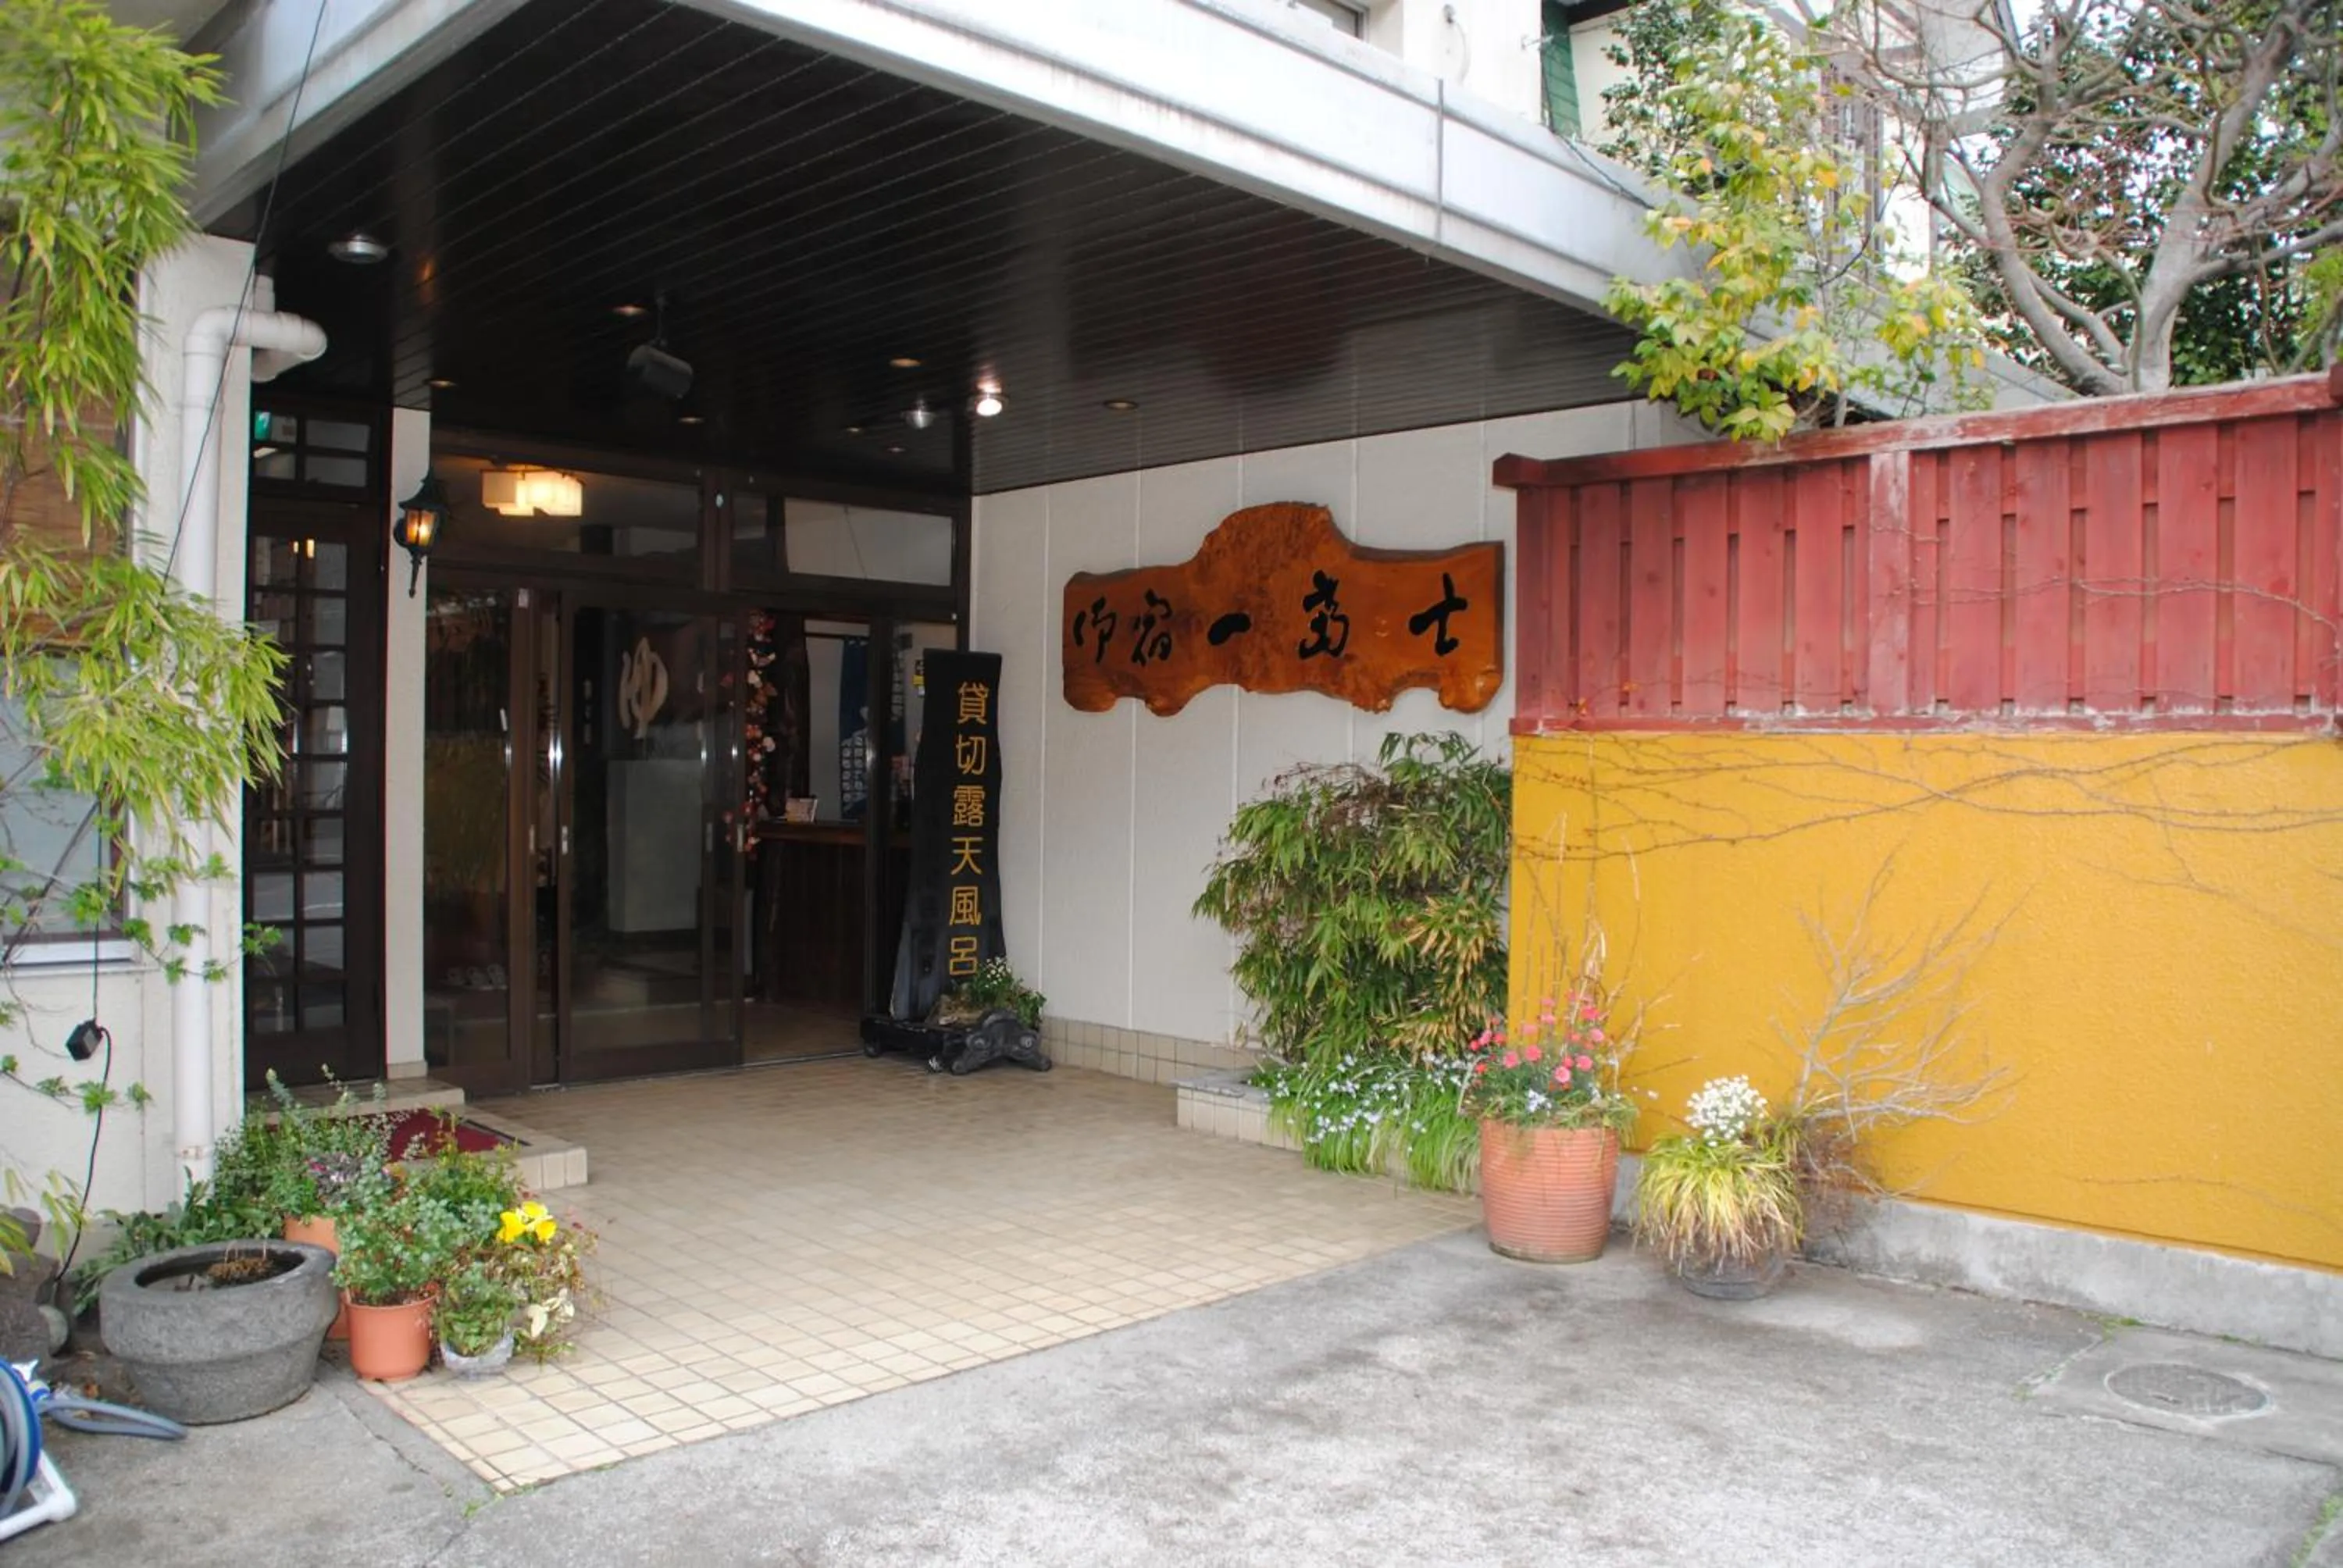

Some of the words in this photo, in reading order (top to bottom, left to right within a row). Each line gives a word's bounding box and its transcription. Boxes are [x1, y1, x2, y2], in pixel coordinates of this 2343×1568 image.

[948, 681, 990, 977] 貸切露天風呂
